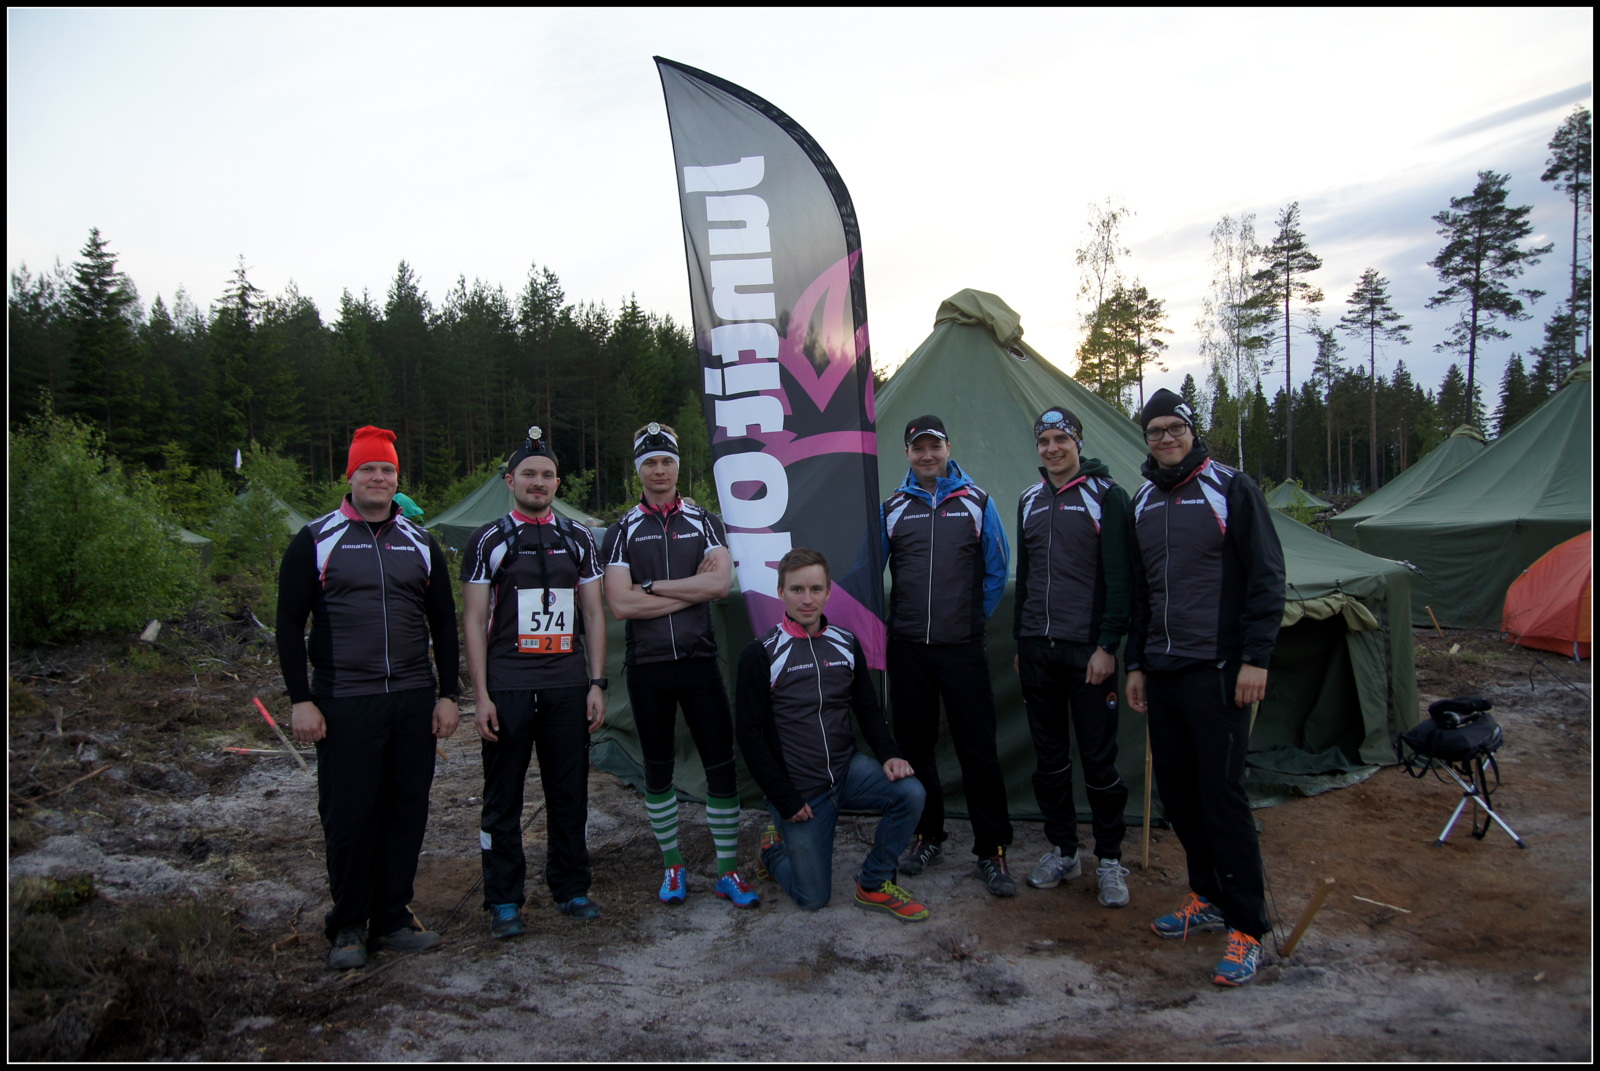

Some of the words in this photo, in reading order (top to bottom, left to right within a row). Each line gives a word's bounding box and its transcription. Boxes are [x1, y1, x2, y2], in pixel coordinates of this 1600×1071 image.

[635, 534, 662, 542] noname
[530, 610, 565, 632] 574
[544, 636, 553, 651] 2
